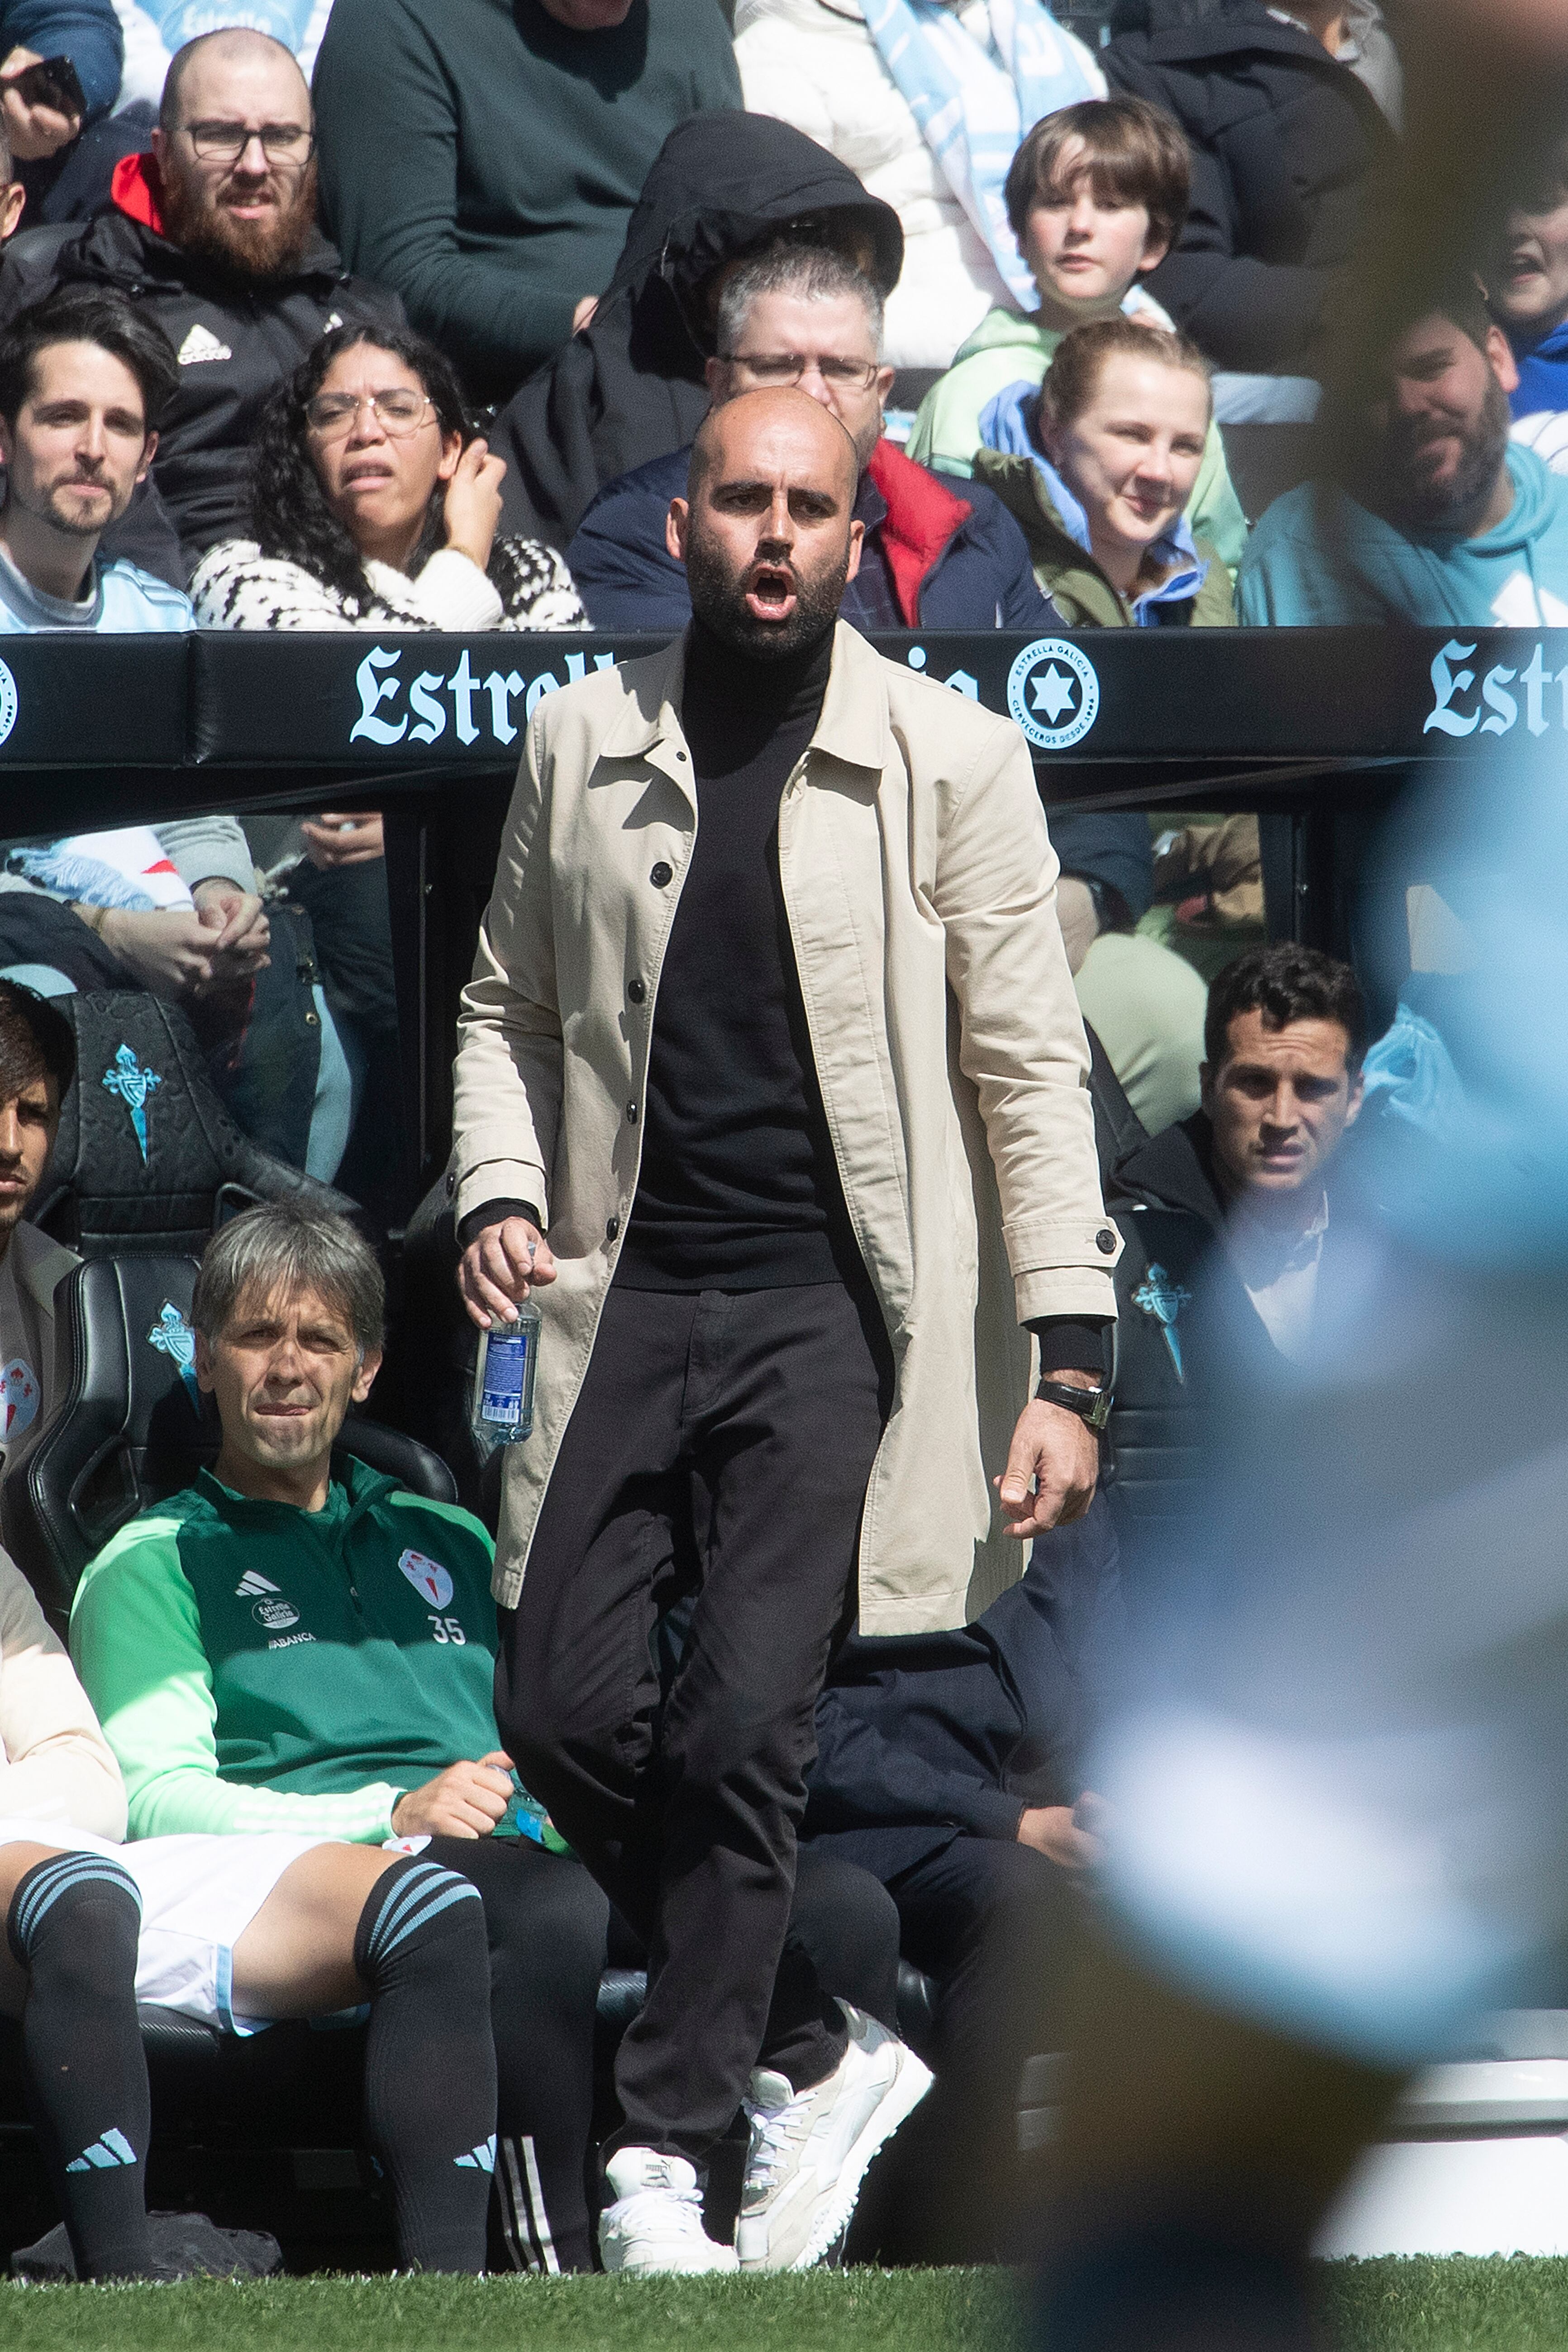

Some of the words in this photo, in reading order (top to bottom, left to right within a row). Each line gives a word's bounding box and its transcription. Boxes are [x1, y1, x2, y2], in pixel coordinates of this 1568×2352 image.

[1015, 645, 1053, 676] ESTRELLA
[1057, 645, 1090, 679] GALICIA
[1012, 700, 1056, 744] CERVECEROS
[1059, 722, 1086, 743] DESDE
[268, 1632, 316, 1650] ABANCA
[428, 1615, 466, 1645] 35
